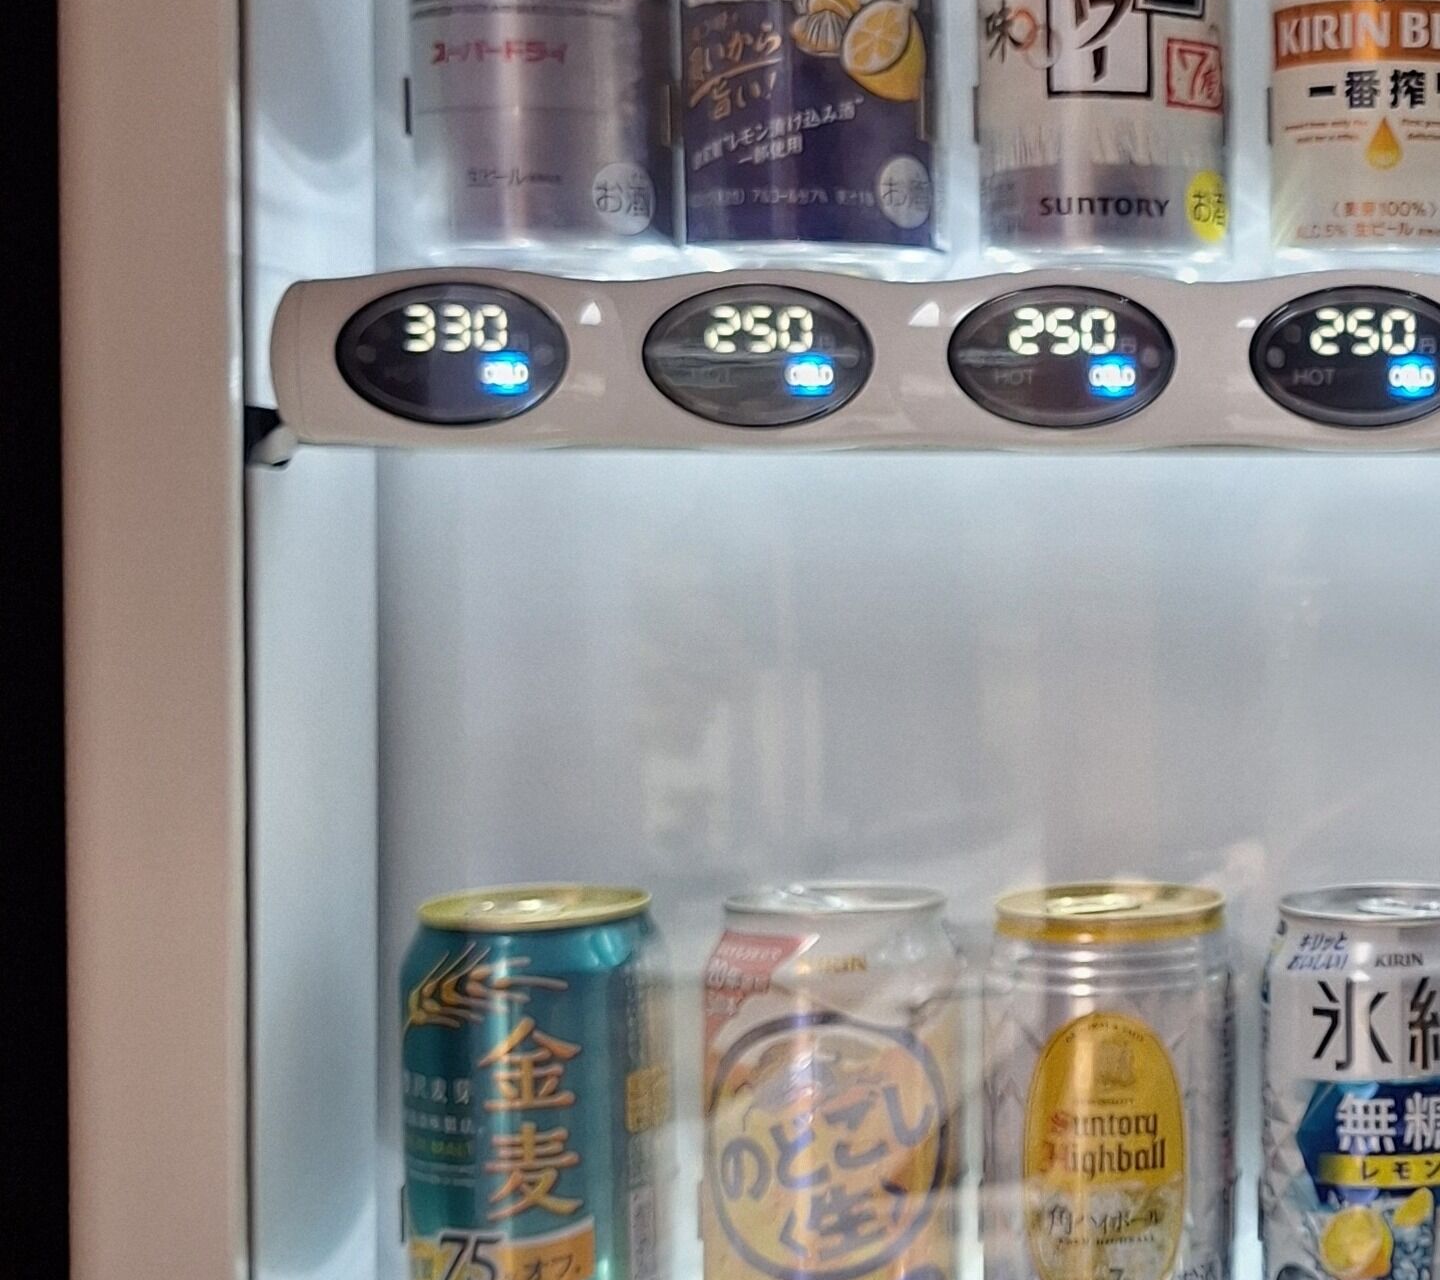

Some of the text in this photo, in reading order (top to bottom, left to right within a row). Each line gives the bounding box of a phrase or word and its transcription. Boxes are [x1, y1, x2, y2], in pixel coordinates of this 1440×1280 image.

[1277, 10, 1391, 57] KIRIN
[402, 303, 508, 353] 330
[703, 305, 813, 354] 250
[1008, 307, 1117, 356] 250
[1310, 308, 1417, 356] 250
[1374, 952, 1424, 968] KIRIN
[478, 1019, 583, 1220] 金麦
